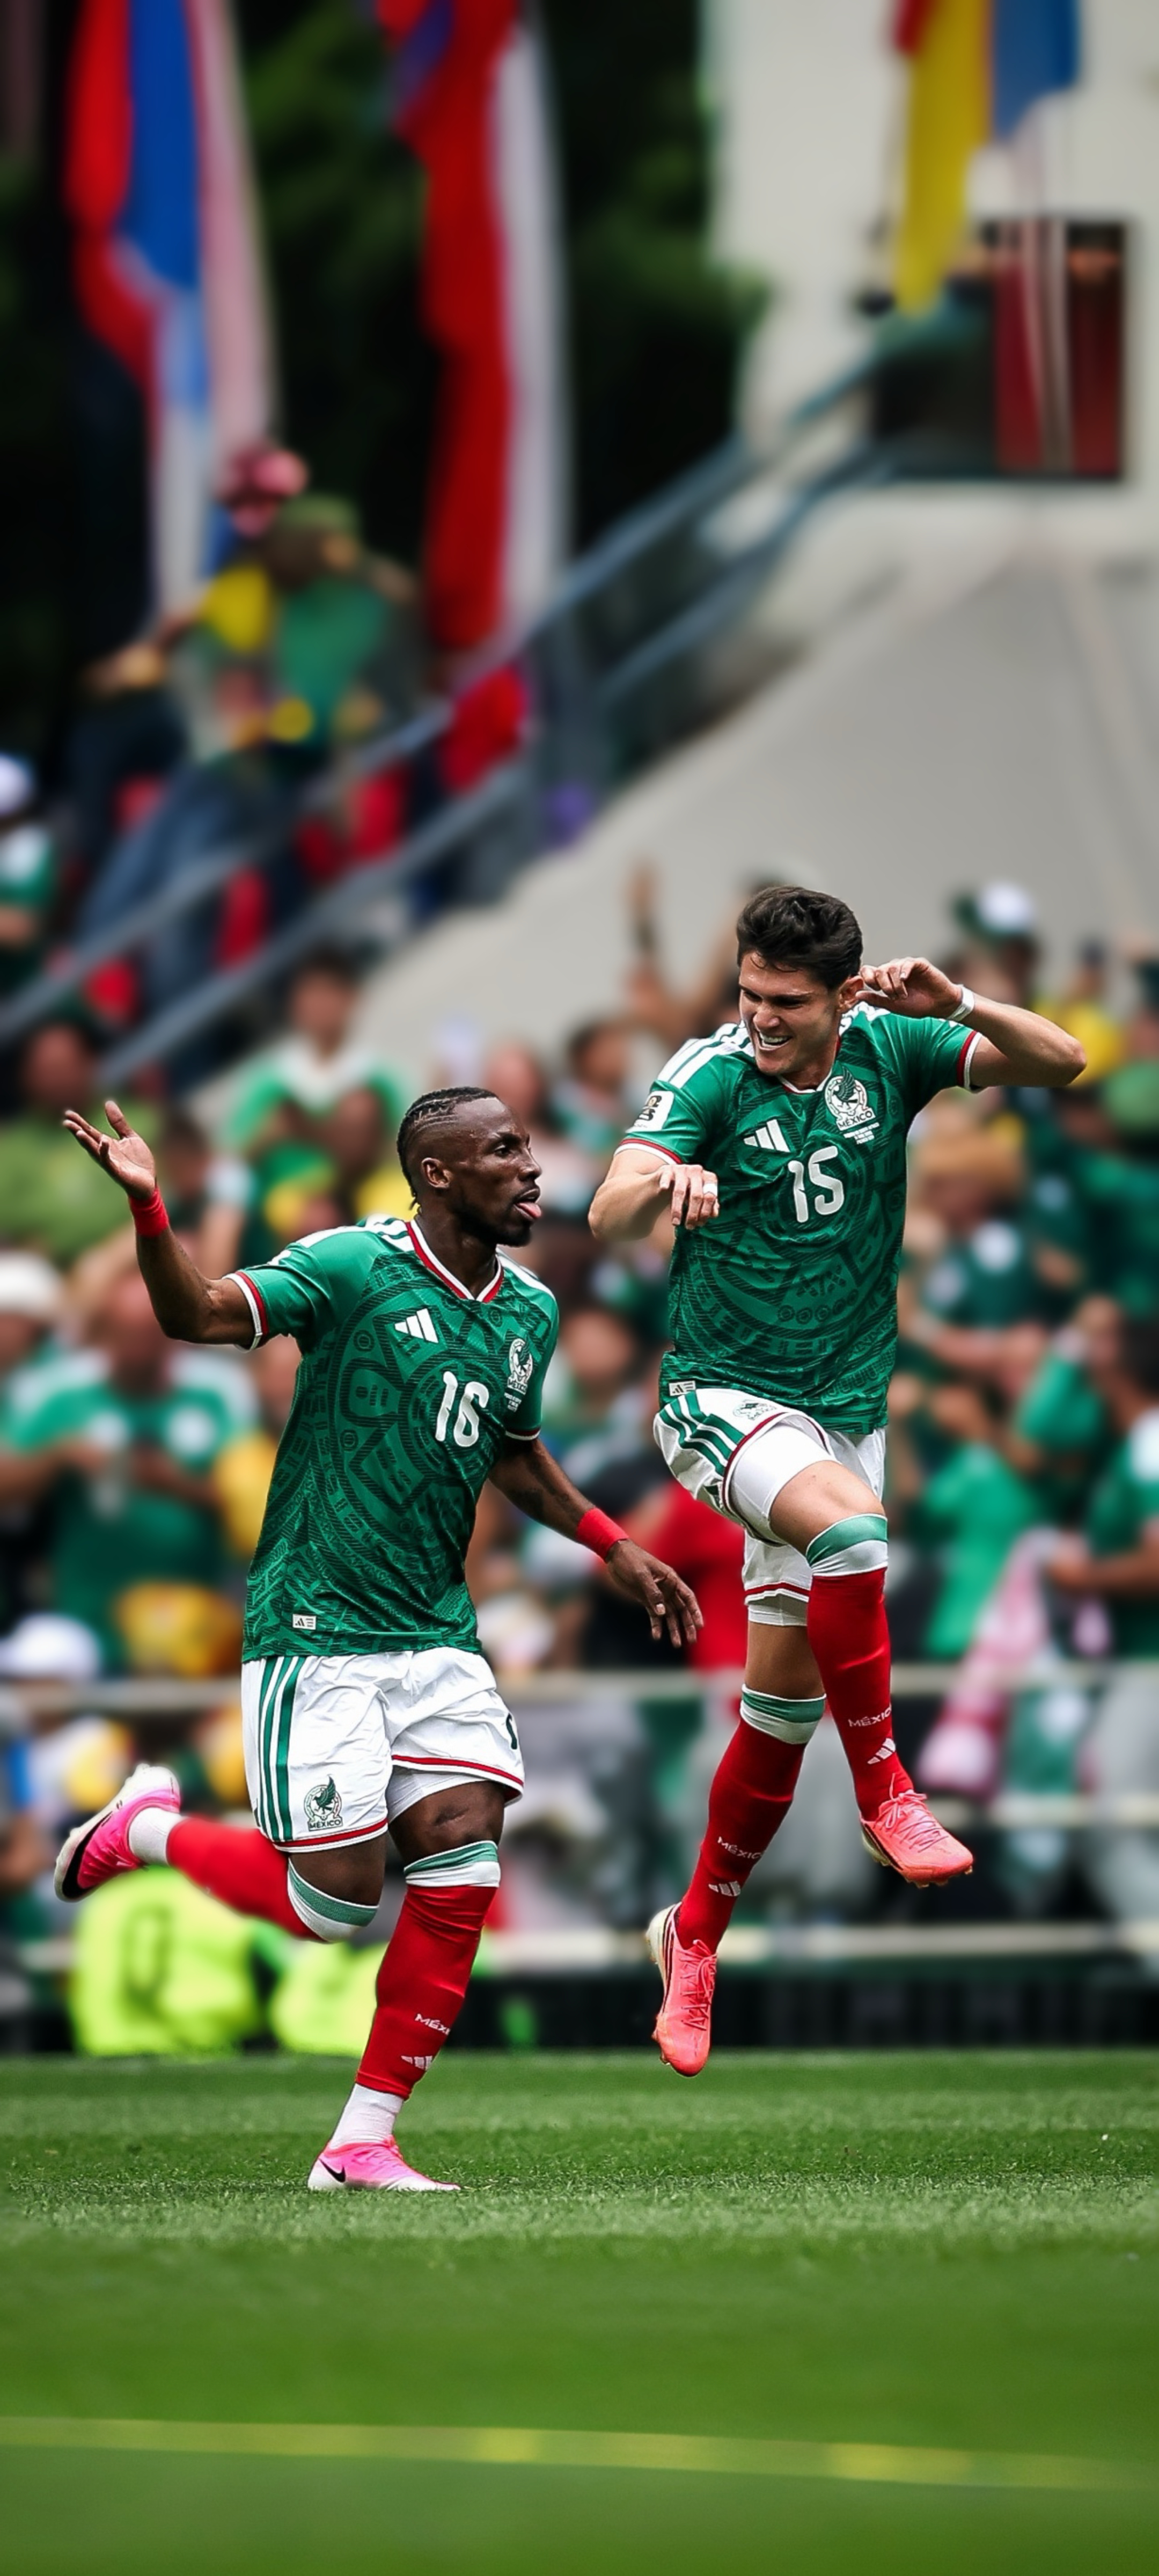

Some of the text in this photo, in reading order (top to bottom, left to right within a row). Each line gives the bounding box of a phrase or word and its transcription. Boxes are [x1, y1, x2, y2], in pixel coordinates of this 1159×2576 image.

[787, 1145, 845, 1223] 15
[435, 1371, 489, 1447] 16
[848, 1703, 892, 1727] MÉXIC
[717, 1836, 761, 1859] MÉXIC
[414, 2013, 450, 2036] MÉXI
